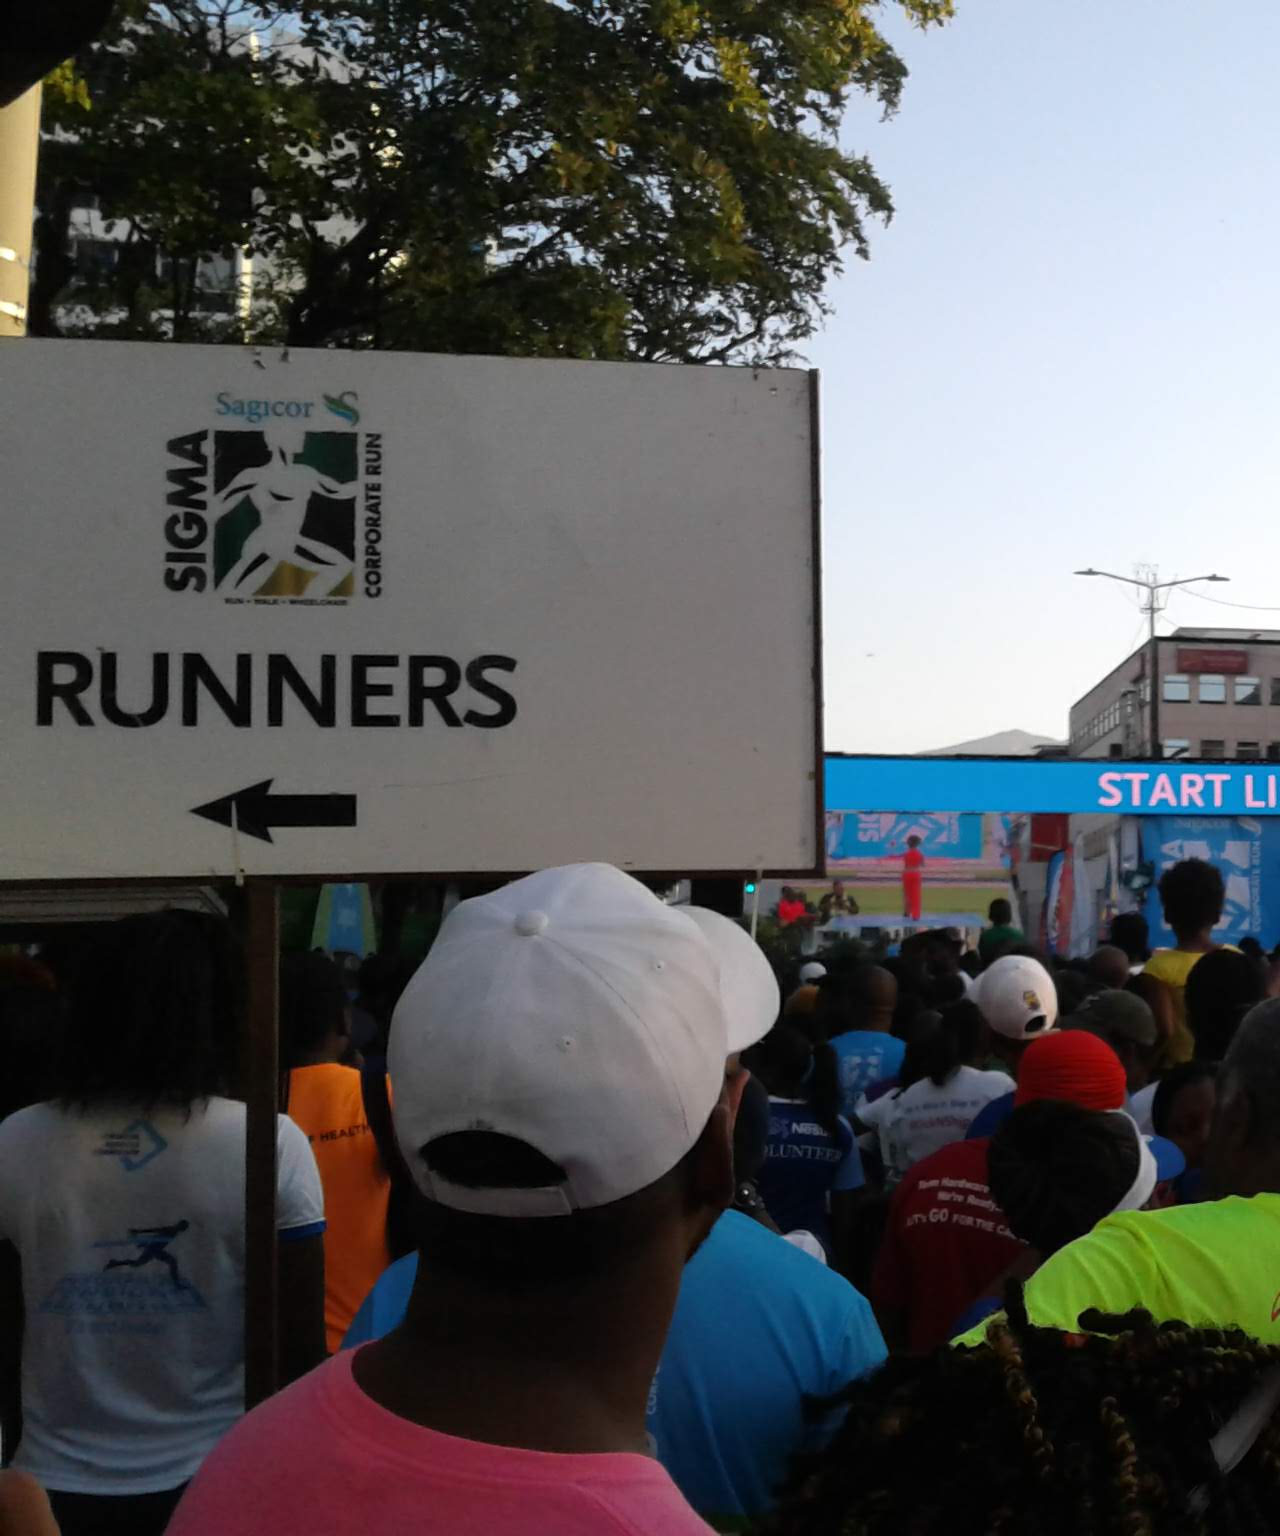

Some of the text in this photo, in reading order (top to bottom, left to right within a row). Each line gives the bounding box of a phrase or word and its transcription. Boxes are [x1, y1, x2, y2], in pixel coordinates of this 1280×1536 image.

[216, 392, 314, 423] Sagicor
[164, 429, 209, 593] SIGMA
[364, 433, 382, 598] CORPORATE RUN
[36, 652, 517, 728] RUNNERS
[1098, 772, 1232, 808] START
[929, 1208, 949, 1223] GO
[952, 1213, 974, 1226] FOR
[975, 1217, 996, 1232] THE
